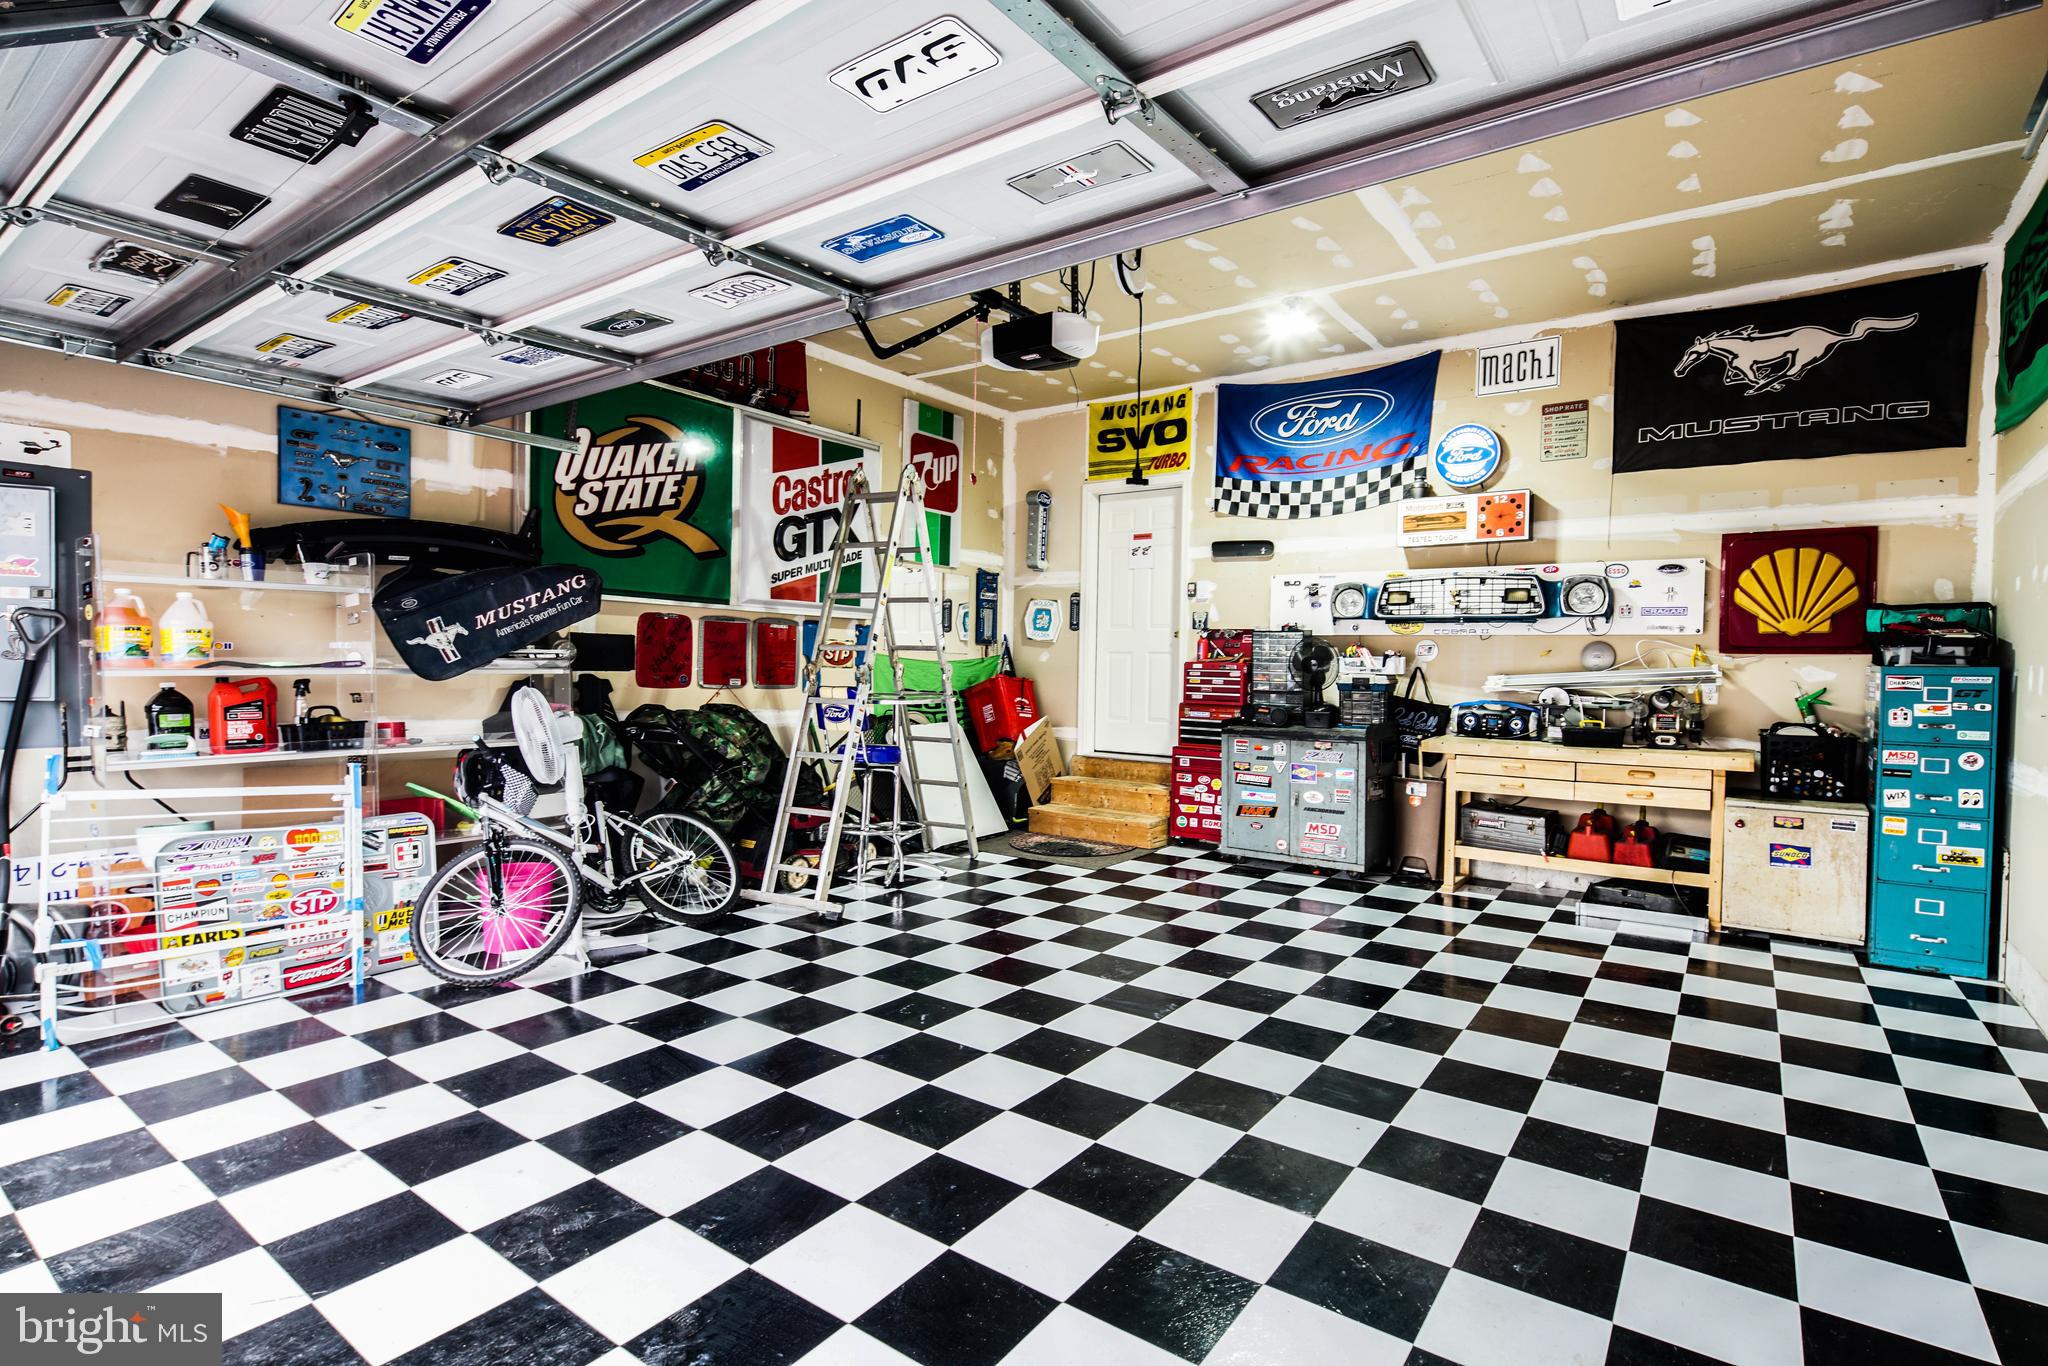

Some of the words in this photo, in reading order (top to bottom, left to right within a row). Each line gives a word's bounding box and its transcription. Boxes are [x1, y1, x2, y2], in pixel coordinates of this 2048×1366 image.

[424, 10, 467, 47] PENNSYLVANIA
[1271, 59, 1406, 114] Mustang
[701, 154, 747, 182] PENNSYLVANIA
[548, 207, 597, 233] 1984
[514, 219, 554, 243] SVO
[842, 225, 921, 255] MUSTANG
[1100, 393, 1187, 421] MUSTANG
[1544, 405, 1564, 414] SHOP
[1278, 399, 1363, 438] Ford
[1637, 400, 1931, 445] MUSTANG
[1097, 417, 1188, 453] SVO
[1229, 431, 1416, 474] RACING
[1447, 448, 1484, 463] Ford
[1149, 451, 1187, 471] TURBO
[1445, 469, 1487, 483] SERVICE
[574, 474, 682, 516] STATE
[1493, 495, 1508, 504] 12
[1478, 513, 1486, 522] 9
[1516, 510, 1524, 520] 3
[773, 502, 862, 562] GTX
[1408, 535, 1433, 543] TESTED
[1495, 528, 1505, 537] 6
[771, 567, 803, 584] SUPER
[1607, 566, 1626, 574] ESSO
[475, 574, 588, 630] MUSTANG
[529, 605, 558, 624] Favorite
[557, 601, 571, 613] Fun
[570, 595, 584, 608] Car
[823, 646, 850, 661] STP
[825, 706, 851, 719] Ford
[1952, 702, 1992, 711] 5.0
[1887, 752, 1916, 760] MSD
[1886, 791, 1907, 801] WIX
[1240, 807, 1273, 816] FAST
[1308, 823, 1338, 835] MSD
[1773, 851, 1808, 859] SUNOCO
[294, 890, 333, 915] STP
[167, 908, 226, 924] CHAMPION
